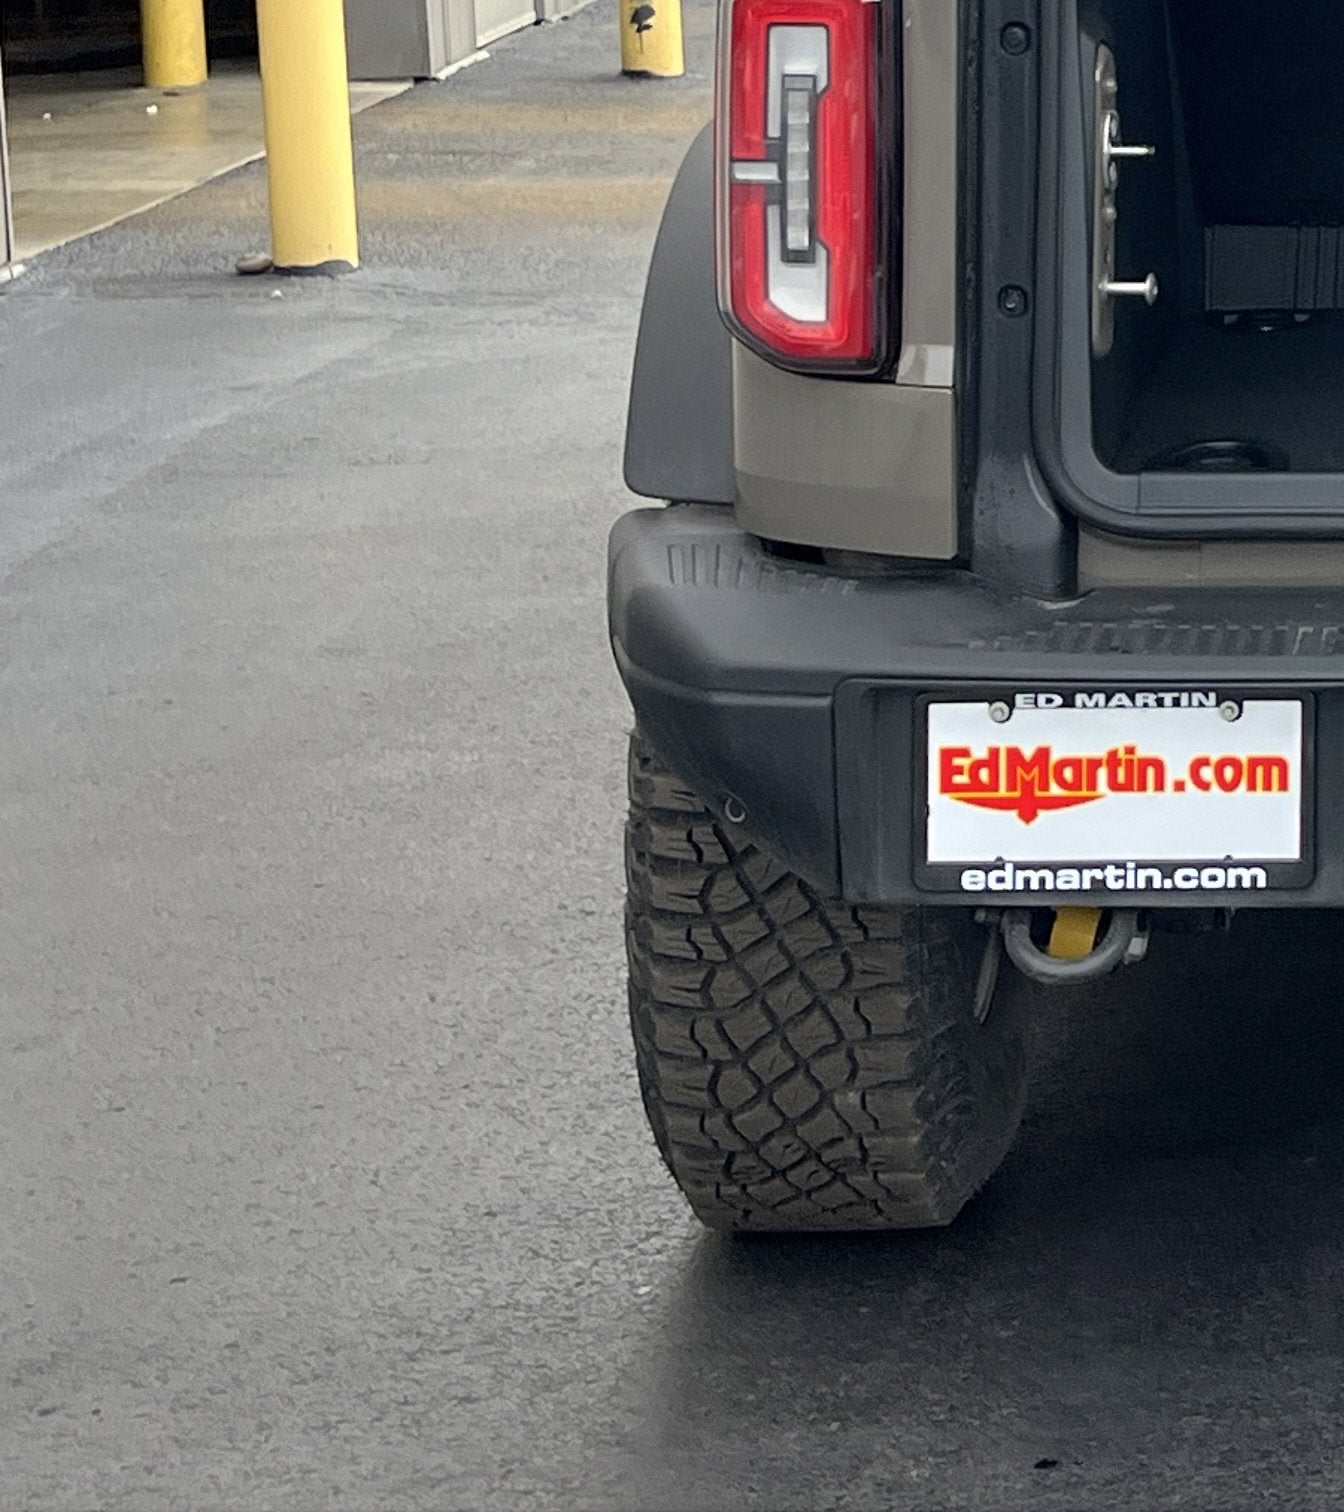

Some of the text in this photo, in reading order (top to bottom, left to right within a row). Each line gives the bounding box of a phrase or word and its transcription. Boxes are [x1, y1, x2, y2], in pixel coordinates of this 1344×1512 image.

[1014, 691, 1217, 709] ED MARTIN
[960, 861, 1267, 890] edmartin.com
